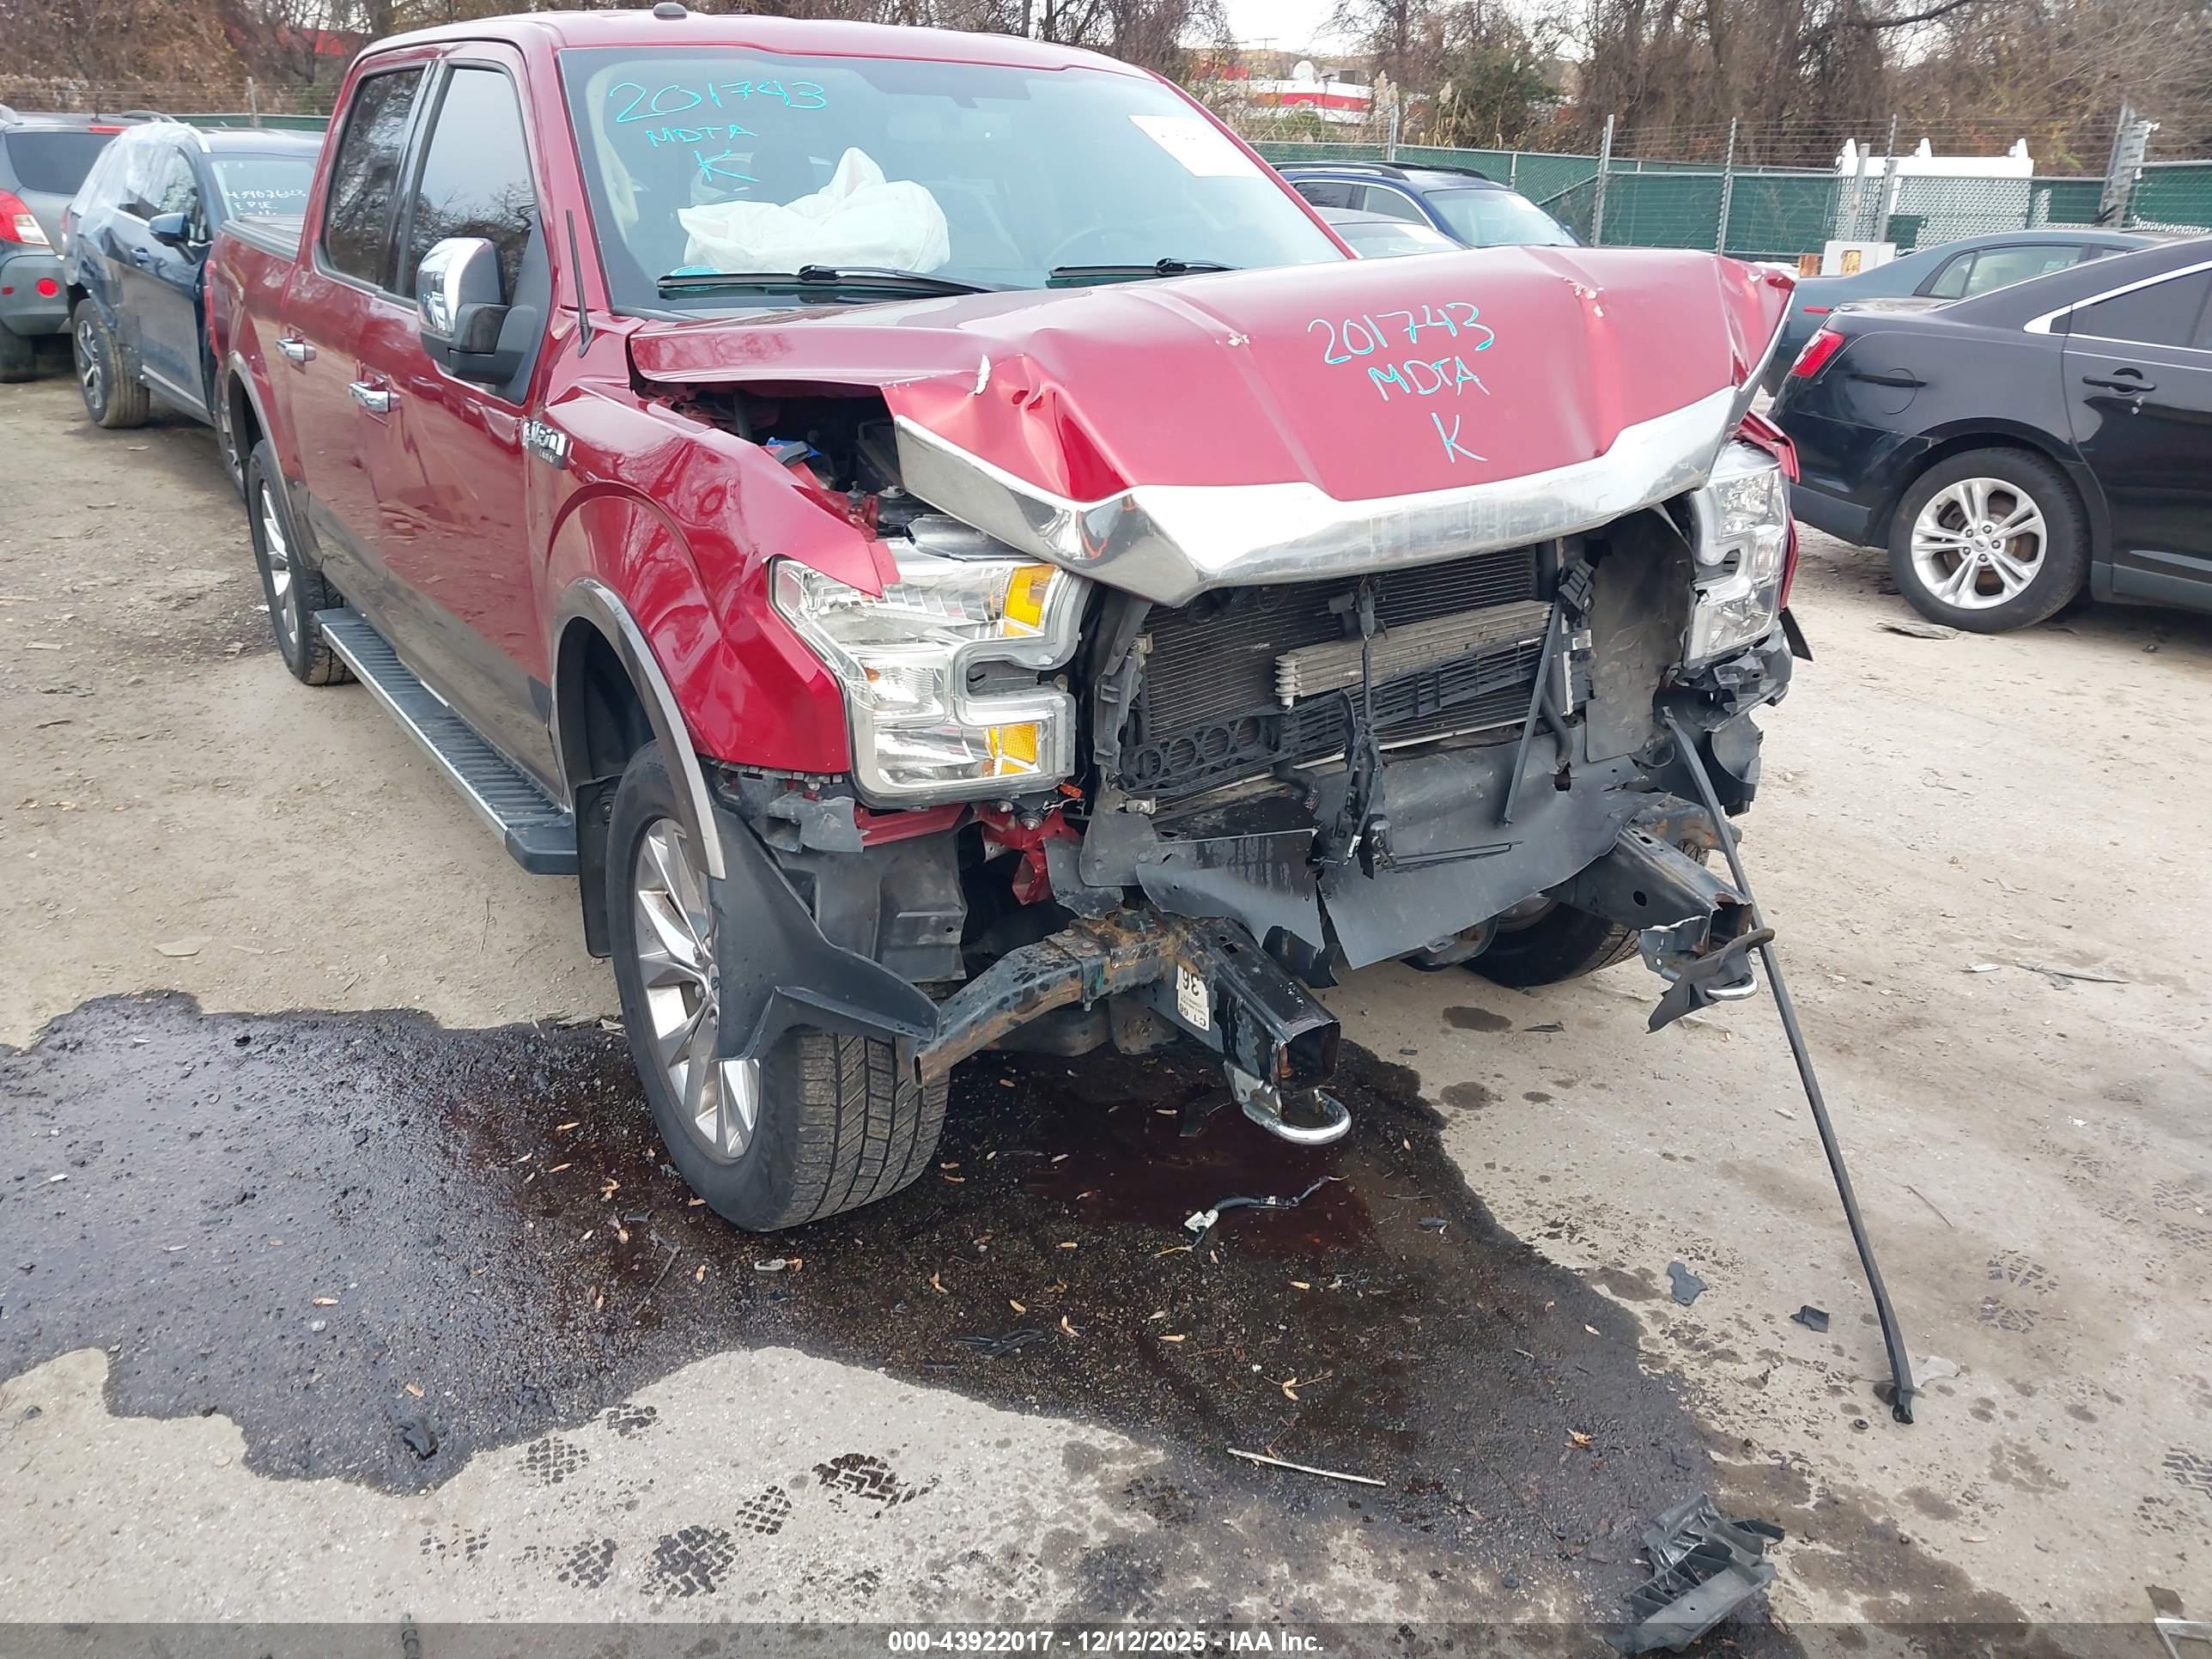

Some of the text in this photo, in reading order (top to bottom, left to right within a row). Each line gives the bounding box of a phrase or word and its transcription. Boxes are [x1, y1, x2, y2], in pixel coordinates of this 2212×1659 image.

[609, 81, 828, 123] 201743
[646, 124, 759, 147] MDTA
[694, 149, 759, 181] K
[1307, 302, 1495, 364] 201743
[1367, 356, 1490, 401] MDTA
[1431, 411, 1490, 463] K
